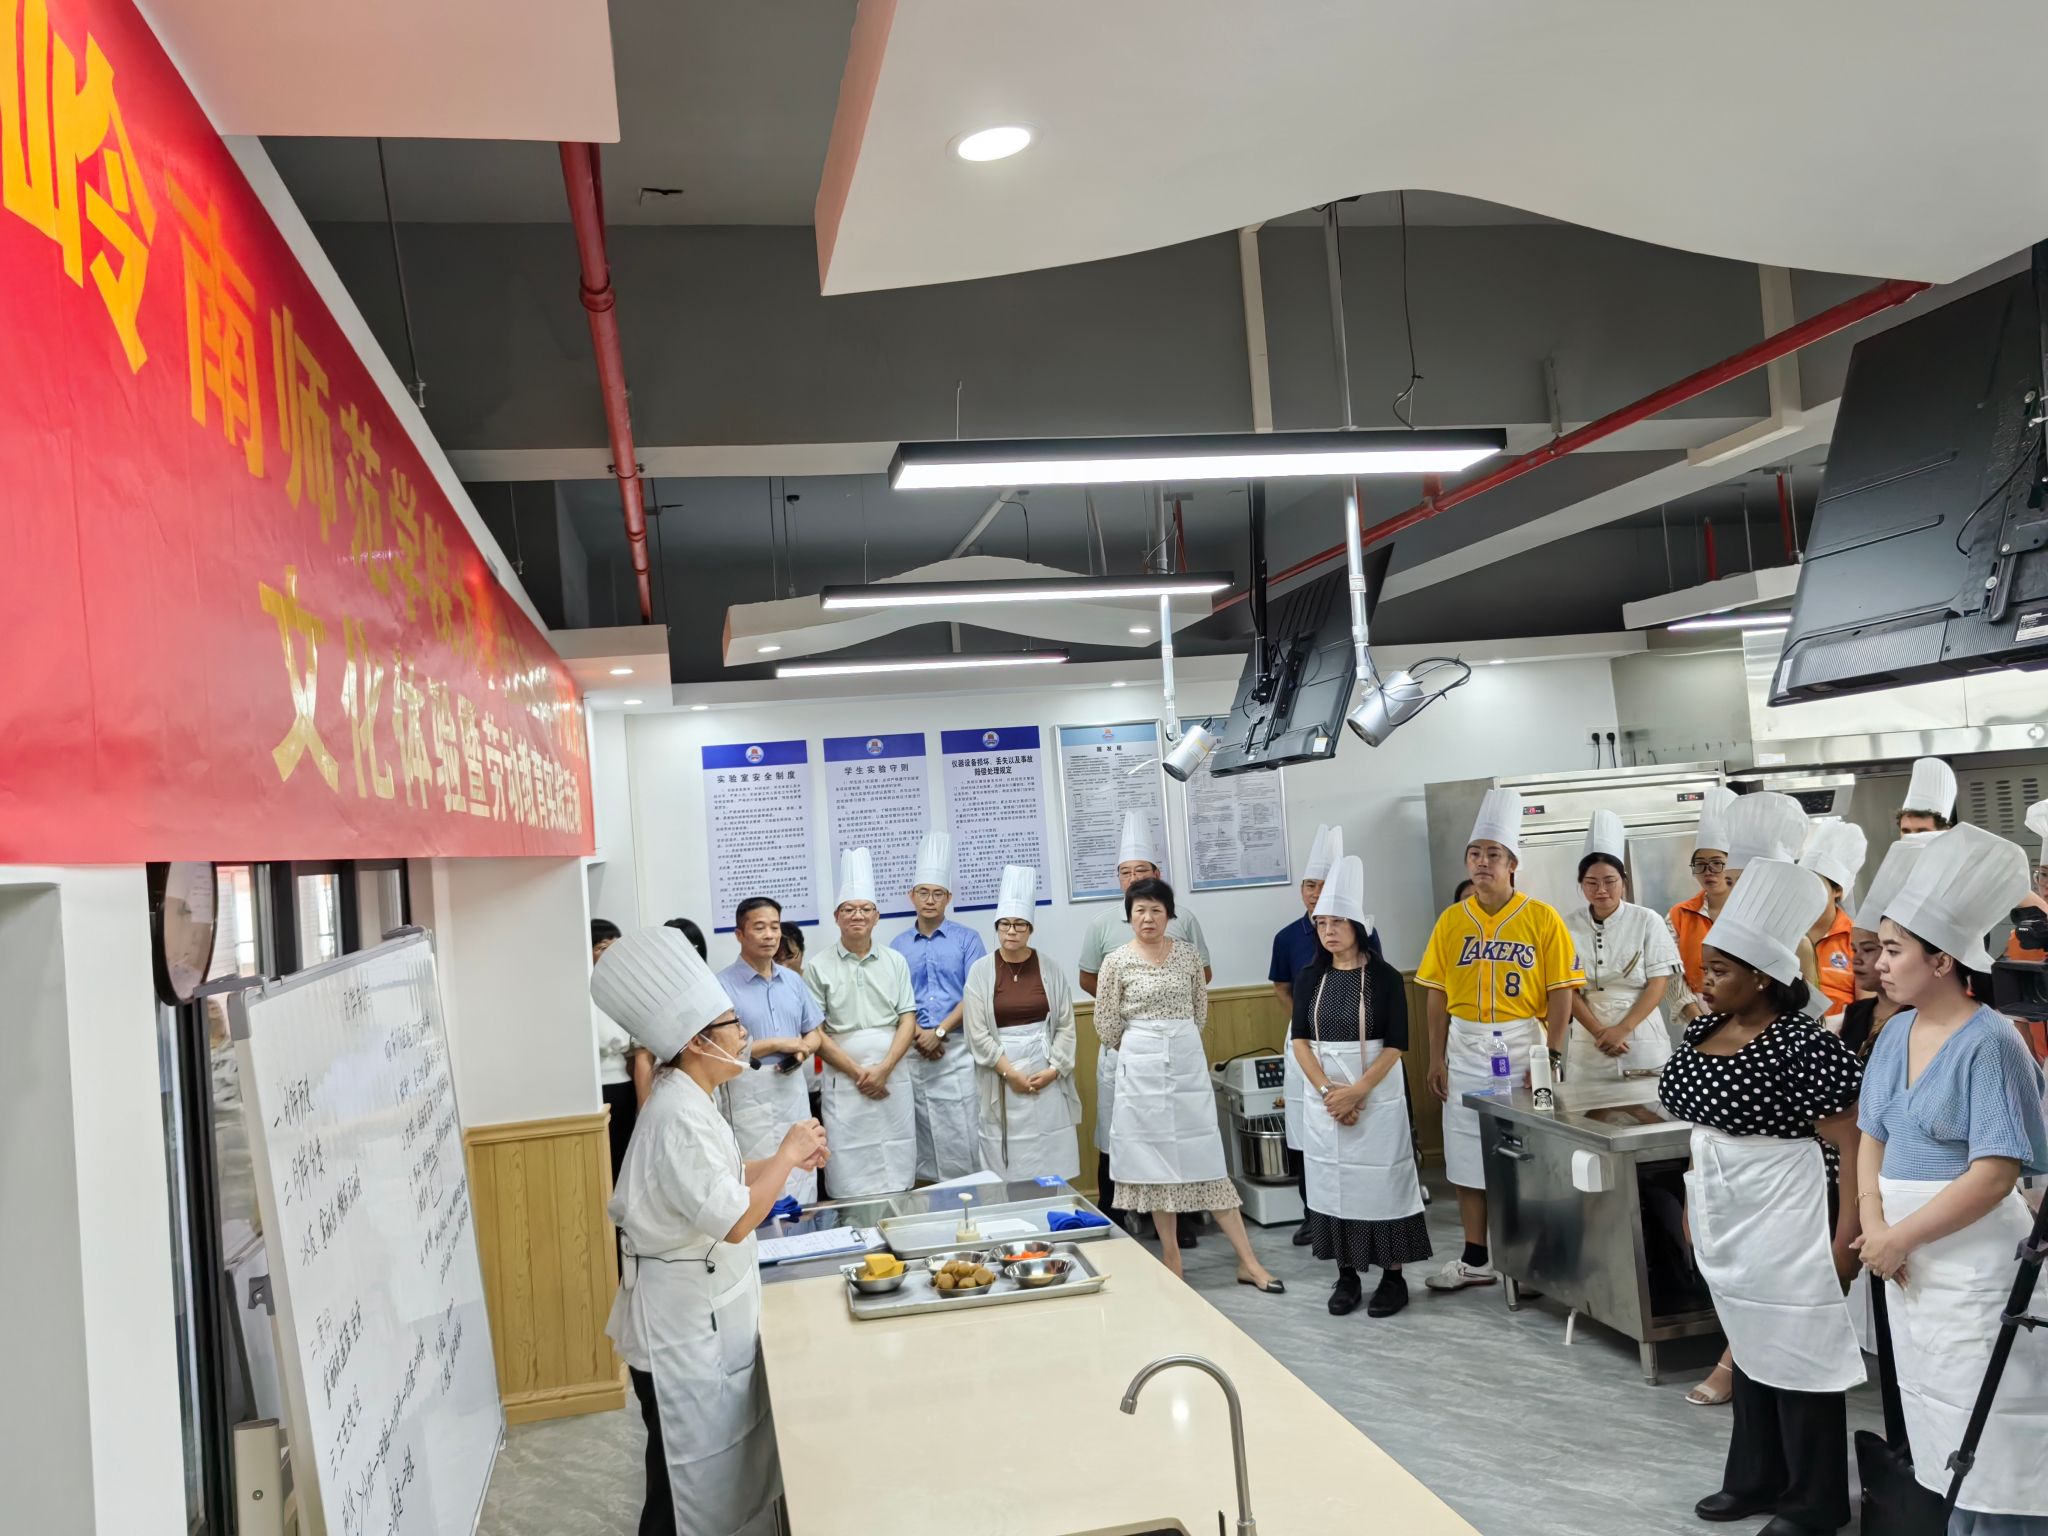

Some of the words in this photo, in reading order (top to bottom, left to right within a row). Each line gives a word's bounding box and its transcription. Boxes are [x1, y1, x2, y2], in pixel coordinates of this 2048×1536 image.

[951, 755, 1033, 768] 仪器设备损坏、丢失以及事故
[844, 763, 909, 775] 学生实验守则
[974, 766, 1012, 776] 赔偿处理规定
[717, 770, 796, 784] 实验室安全制度
[1457, 936, 1536, 969] LAKERS
[1505, 972, 1521, 997] 8
